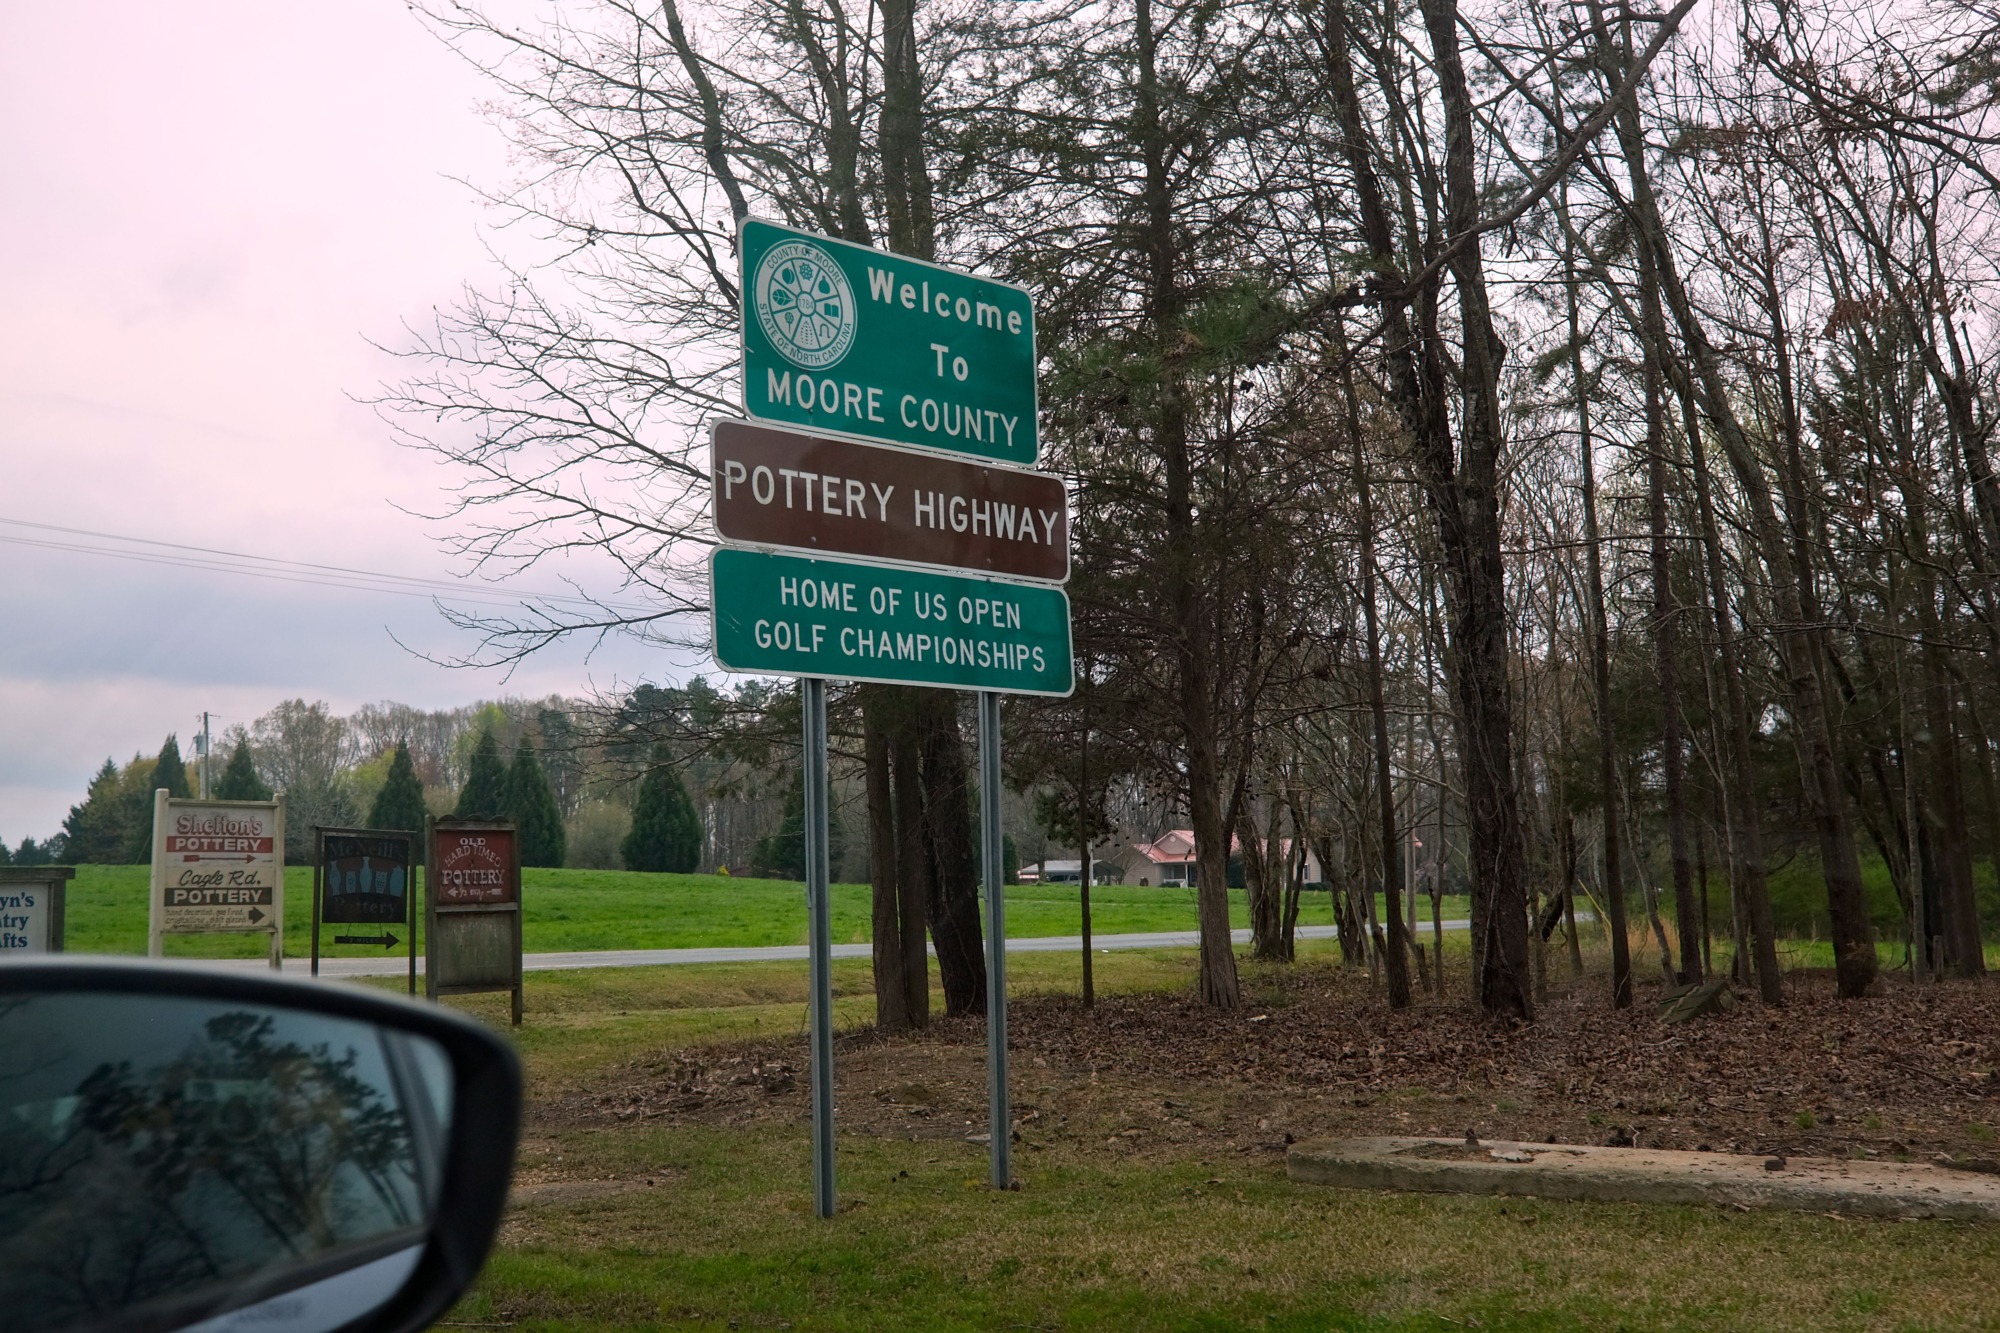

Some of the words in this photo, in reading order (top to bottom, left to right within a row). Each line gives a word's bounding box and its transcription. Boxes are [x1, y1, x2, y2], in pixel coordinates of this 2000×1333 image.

[766, 245, 799, 269] COUNTY
[801, 247, 814, 257] OF
[814, 252, 844, 286] MOORE
[797, 298, 814, 310] 1784
[867, 266, 1022, 335] Welcome
[759, 302, 779, 339] STATE
[777, 337, 790, 351] OF
[789, 347, 821, 364] NORTH
[822, 322, 852, 362] CAROLINA
[930, 342, 969, 382] To
[767, 367, 885, 423] MOORE
[900, 394, 1019, 447] COUNTY
[724, 459, 895, 522] POTTERY
[914, 489, 1059, 546] HIGHWAY
[780, 576, 858, 612] HOME
[870, 586, 903, 617] OF
[914, 591, 948, 621] US
[958, 596, 1022, 630] OPEN
[754, 619, 827, 653] GOLF
[840, 626, 1046, 673] CHAMPIONSHIPS
[176, 814, 263, 837] Shelton's
[175, 837, 262, 851] POTTERY
[459, 837, 486, 846] OLD
[444, 845, 471, 867] HARD
[179, 869, 224, 888] Cagle
[228, 870, 262, 885] Rd.
[441, 869, 505, 885] POTTERY
[173, 889, 263, 904] POTTERY
[0, 913, 29, 931] try
[0, 932, 28, 948] fts
